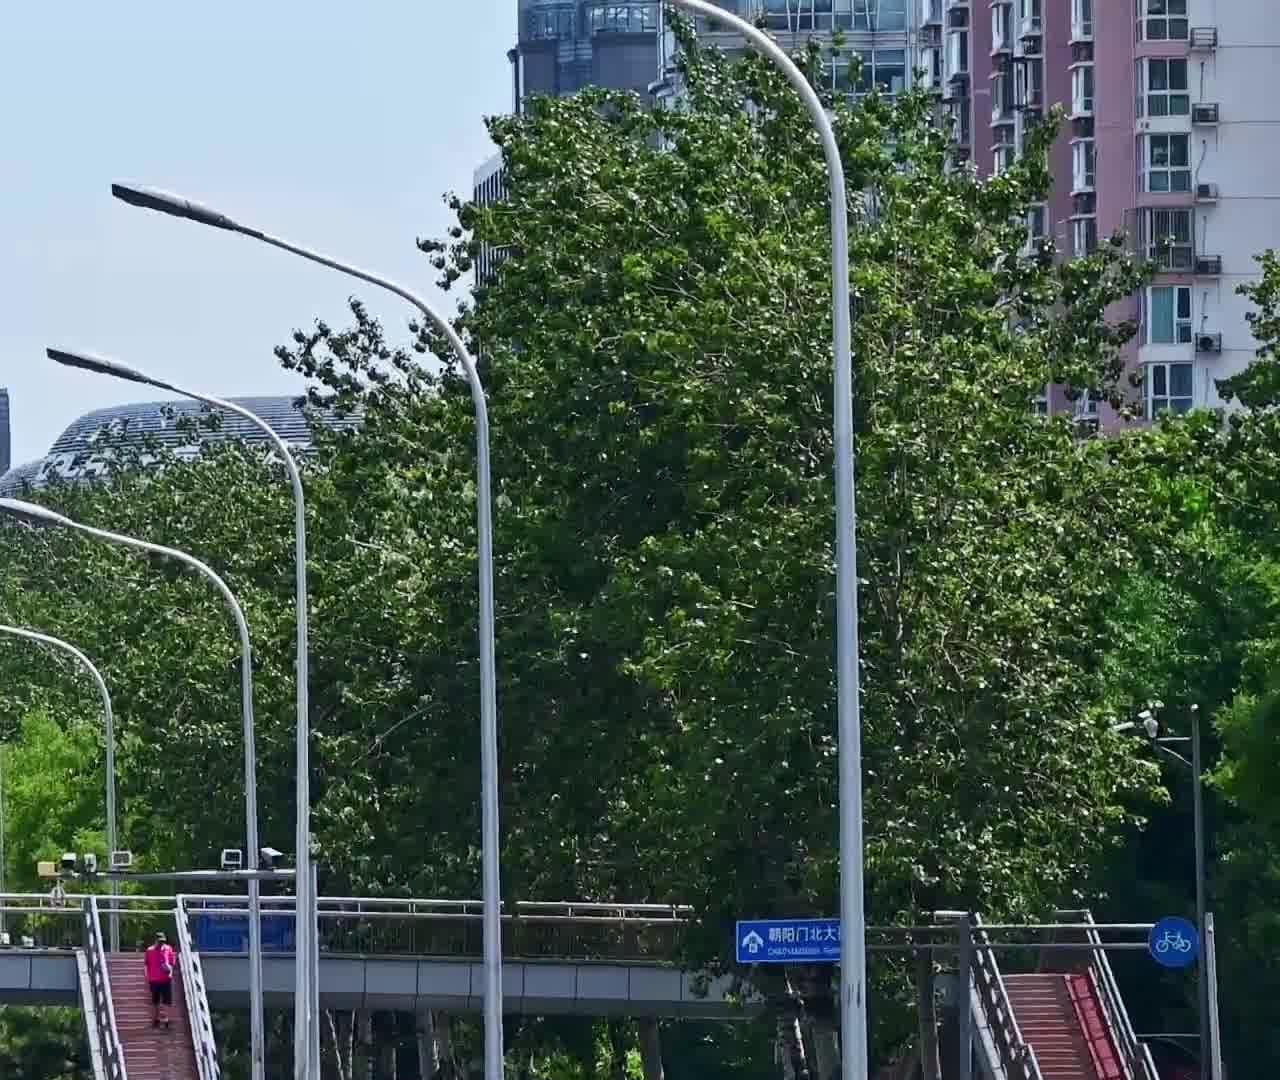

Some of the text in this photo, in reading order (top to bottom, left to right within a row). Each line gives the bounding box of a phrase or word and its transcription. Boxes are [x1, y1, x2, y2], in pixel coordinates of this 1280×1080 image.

[768, 926, 840, 942] 朝阳门北大
